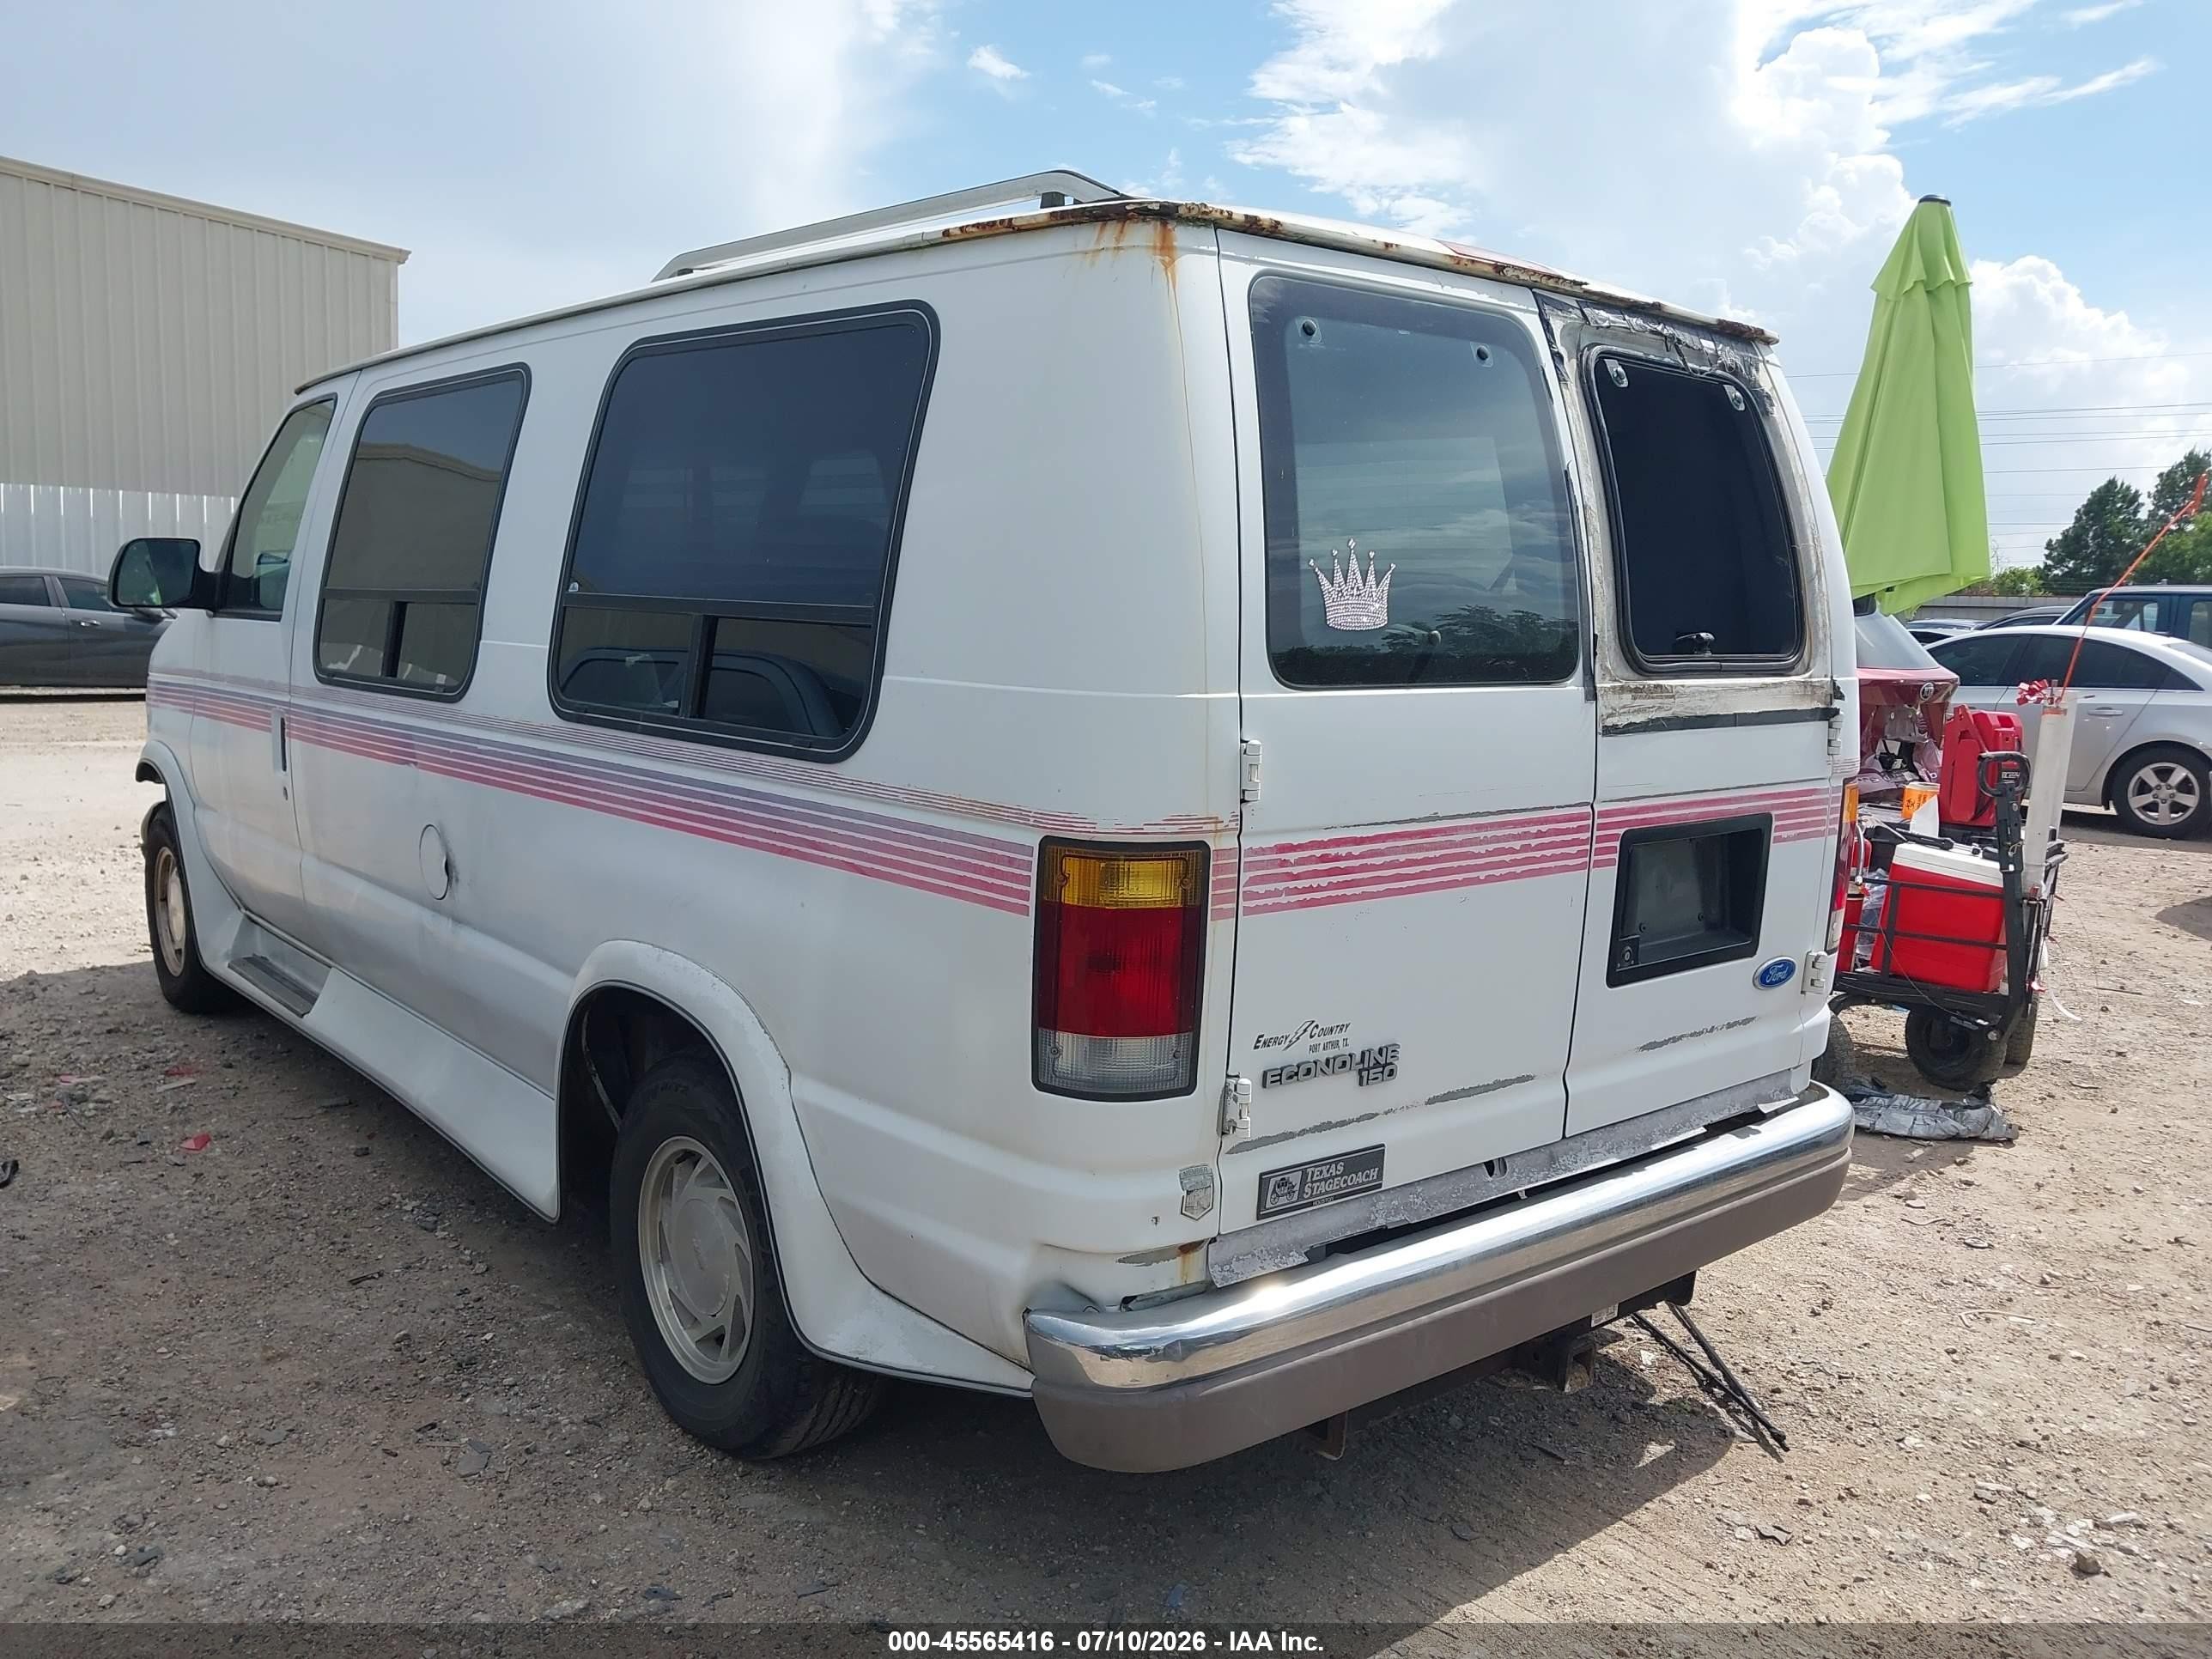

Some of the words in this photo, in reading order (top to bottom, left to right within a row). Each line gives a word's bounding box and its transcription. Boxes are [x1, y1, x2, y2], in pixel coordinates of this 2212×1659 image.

[1765, 963, 1788, 983] Ford
[1309, 1023, 1352, 1039] COUNTRY
[1309, 1042, 1321, 1054] PORT
[1262, 1044, 1401, 1088] ECONOLINE
[1358, 1063, 1398, 1087] 150
[1305, 1162, 1345, 1182] TEXAS
[1303, 1167, 1379, 1198] STAGECOACH
